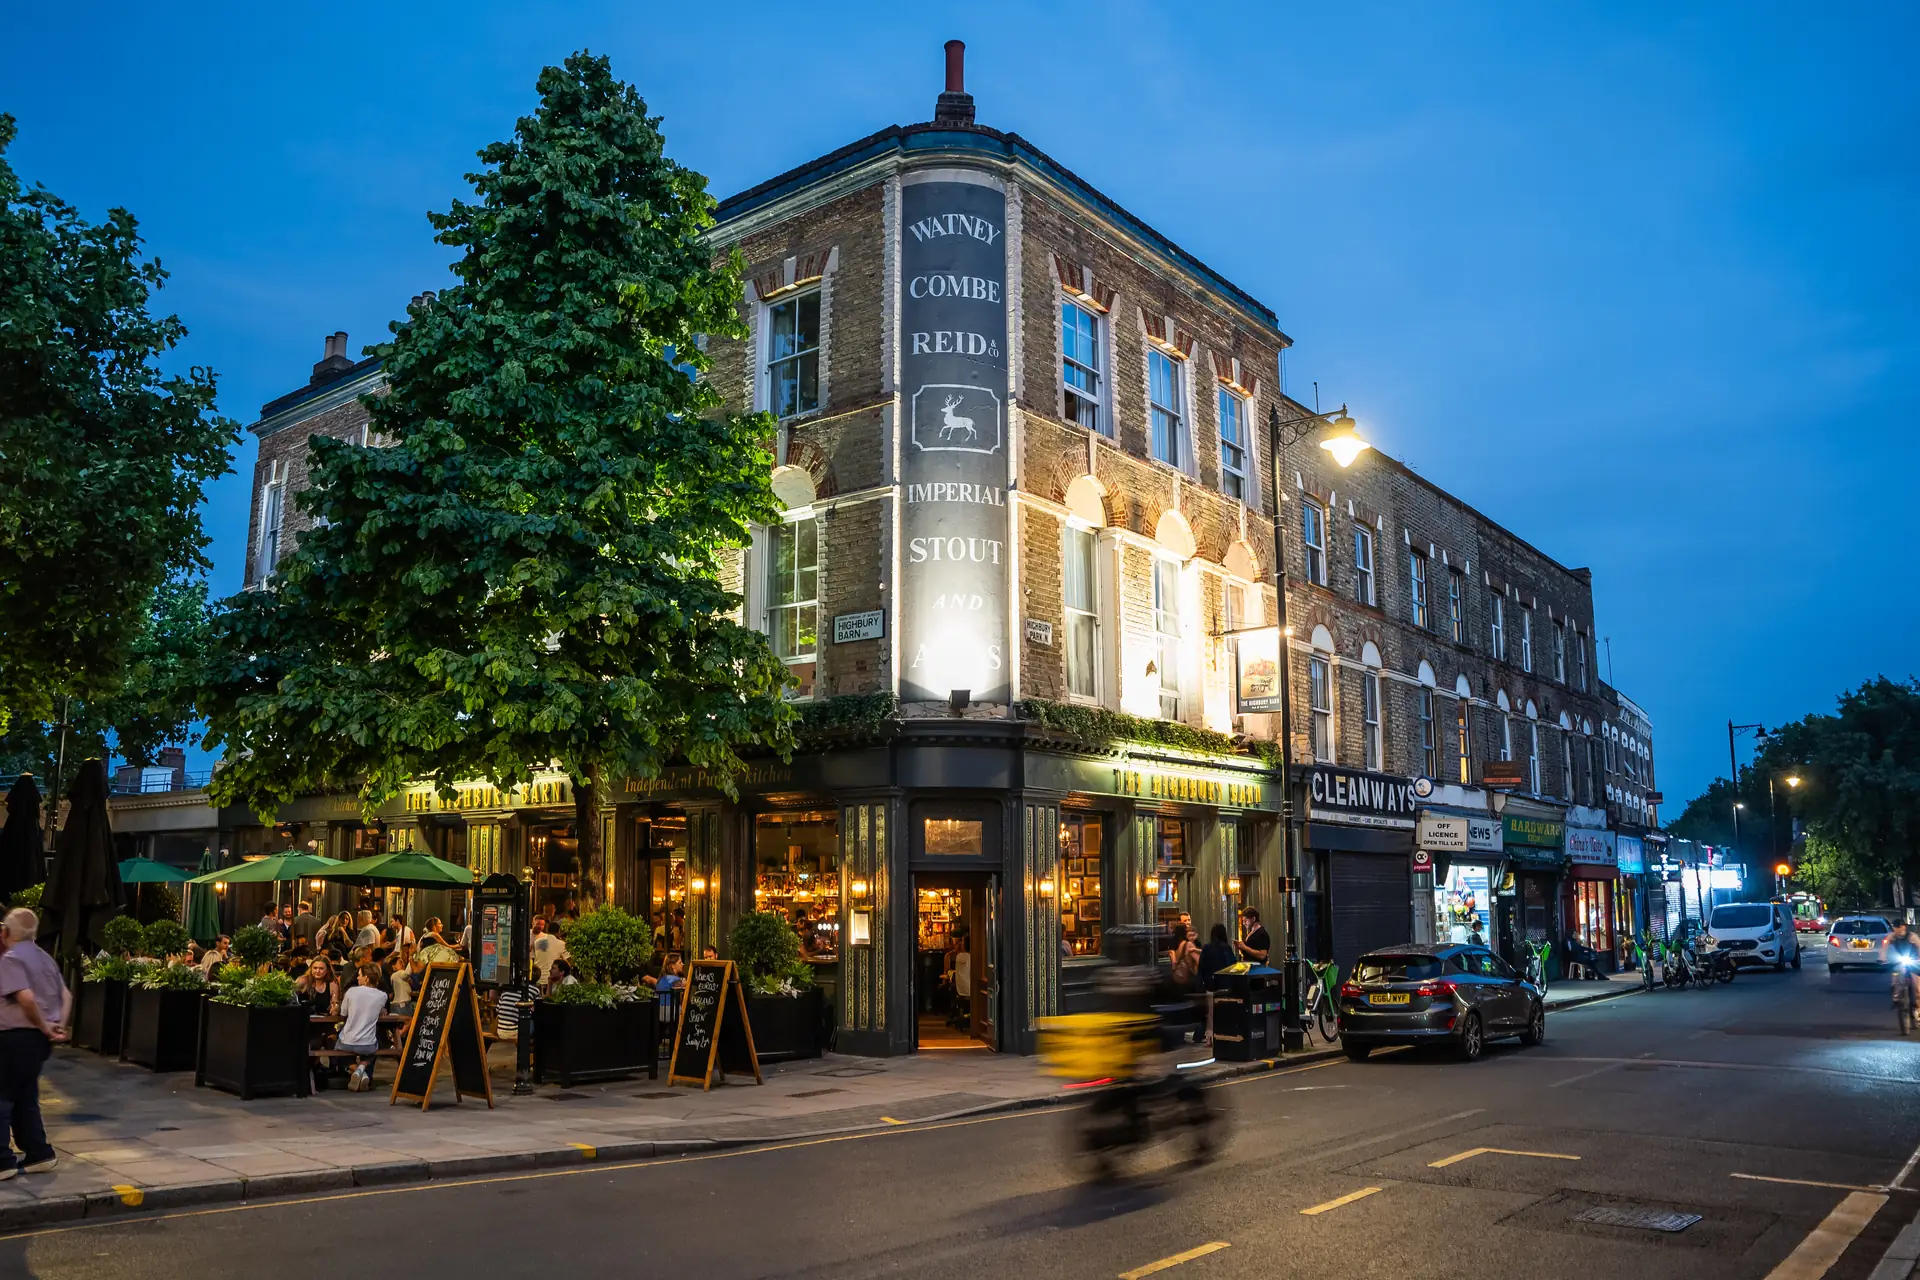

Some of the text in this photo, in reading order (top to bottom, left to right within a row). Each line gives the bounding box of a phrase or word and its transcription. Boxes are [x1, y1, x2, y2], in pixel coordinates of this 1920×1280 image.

[909, 213, 1001, 246] WATNEY
[909, 275, 1001, 304] COMBE
[911, 331, 987, 356] REID
[990, 339, 998, 349] &
[907, 482, 1005, 507] IMPERIAL
[909, 536, 1003, 564] STOUT
[931, 594, 983, 611] AND
[838, 616, 880, 631] HIGHBURY
[838, 629, 861, 641] BARN
[1026, 620, 1051, 634] HIGHBURY
[1030, 631, 1043, 642] PARK
[911, 643, 1002, 670] AS
[624, 771, 692, 797] Independent
[744, 764, 792, 785] kitchen
[1151, 773, 1223, 803] HIGHBURY
[1229, 783, 1262, 807] BARN
[1312, 771, 1416, 813] CLEANWAYS
[404, 790, 430, 811] THE
[520, 780, 562, 805] BARN
[1428, 831, 1459, 839] LICENCE
[1511, 818, 1560, 836] HARDWARE
